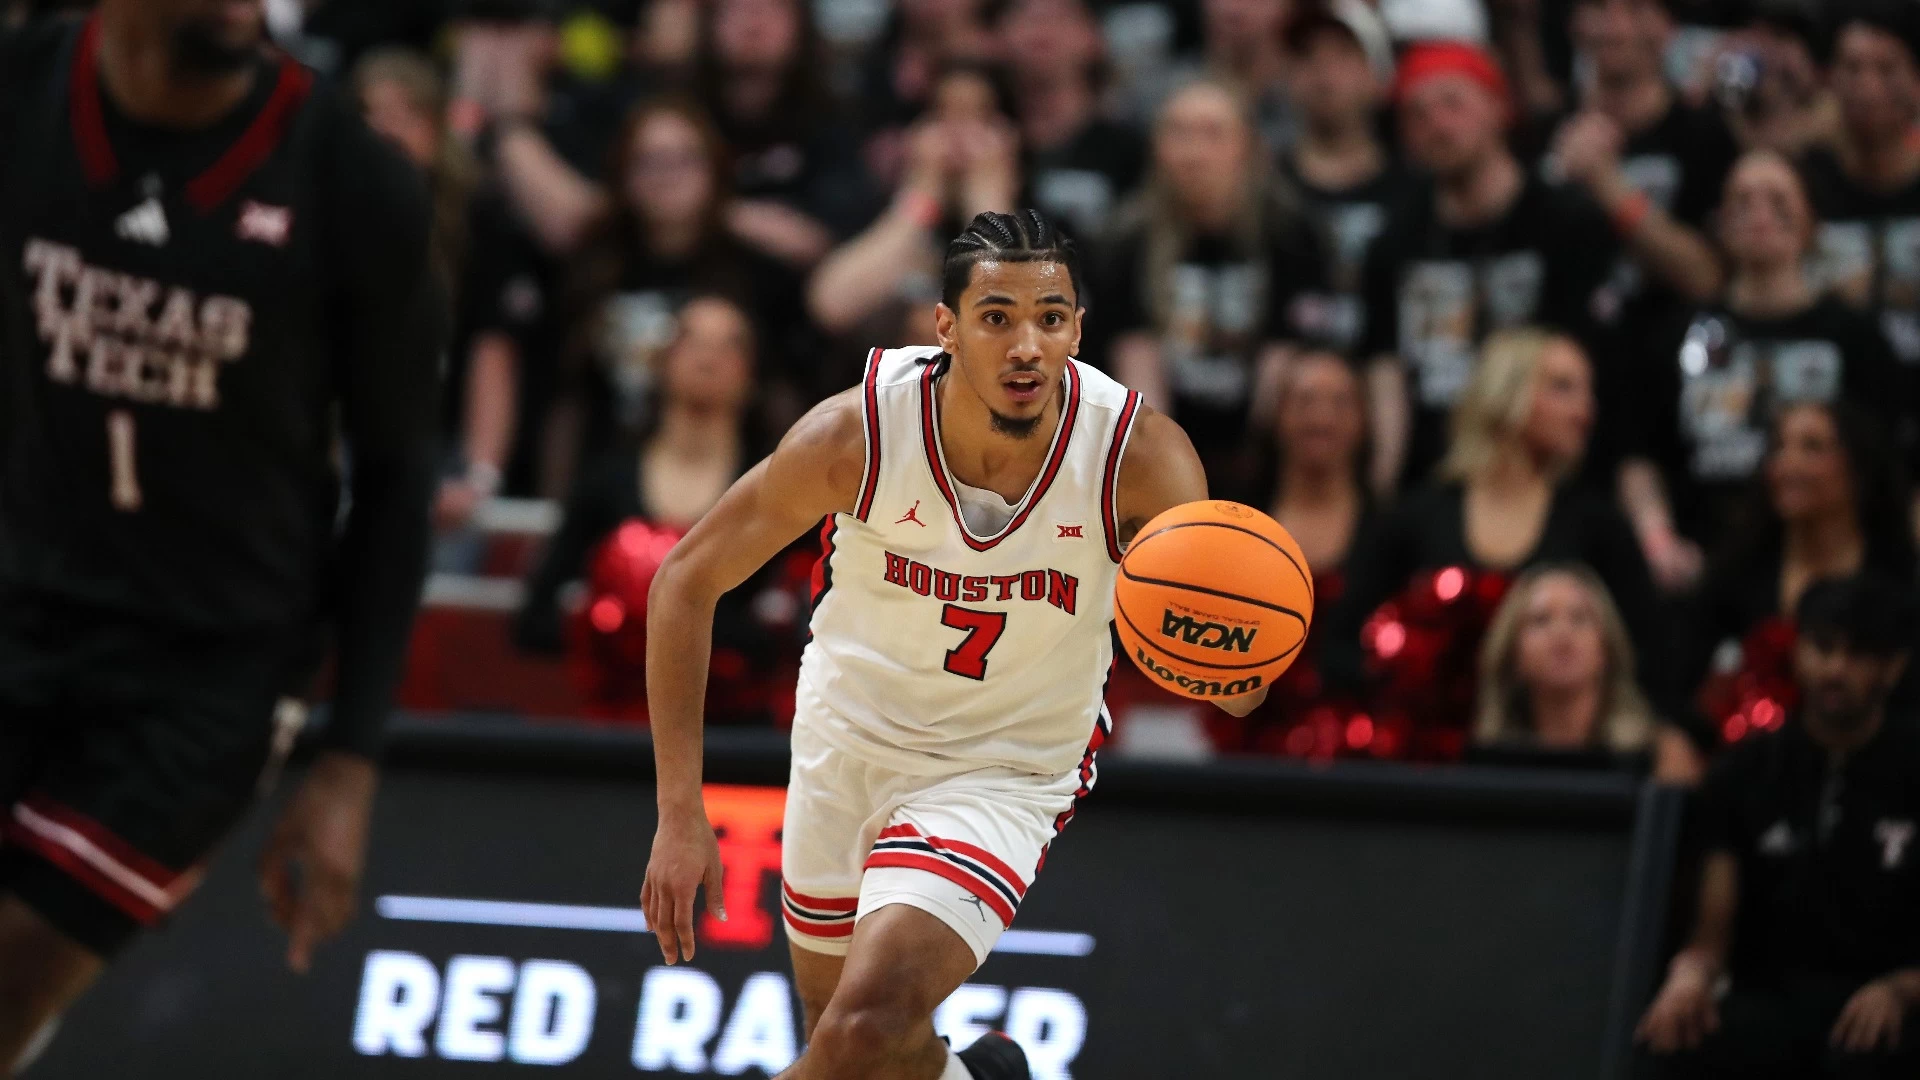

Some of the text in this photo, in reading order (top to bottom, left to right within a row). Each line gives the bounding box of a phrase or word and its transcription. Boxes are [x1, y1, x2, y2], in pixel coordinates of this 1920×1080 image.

[22, 238, 252, 361] TEXAS
[36, 302, 220, 409] TECH
[106, 410, 143, 511] 1
[884, 550, 1079, 616] HOUSTON
[940, 603, 1007, 681] 7
[1137, 646, 1262, 696] Wilson
[1161, 608, 1257, 653] NCAA
[351, 949, 1089, 1080] RED RAER
